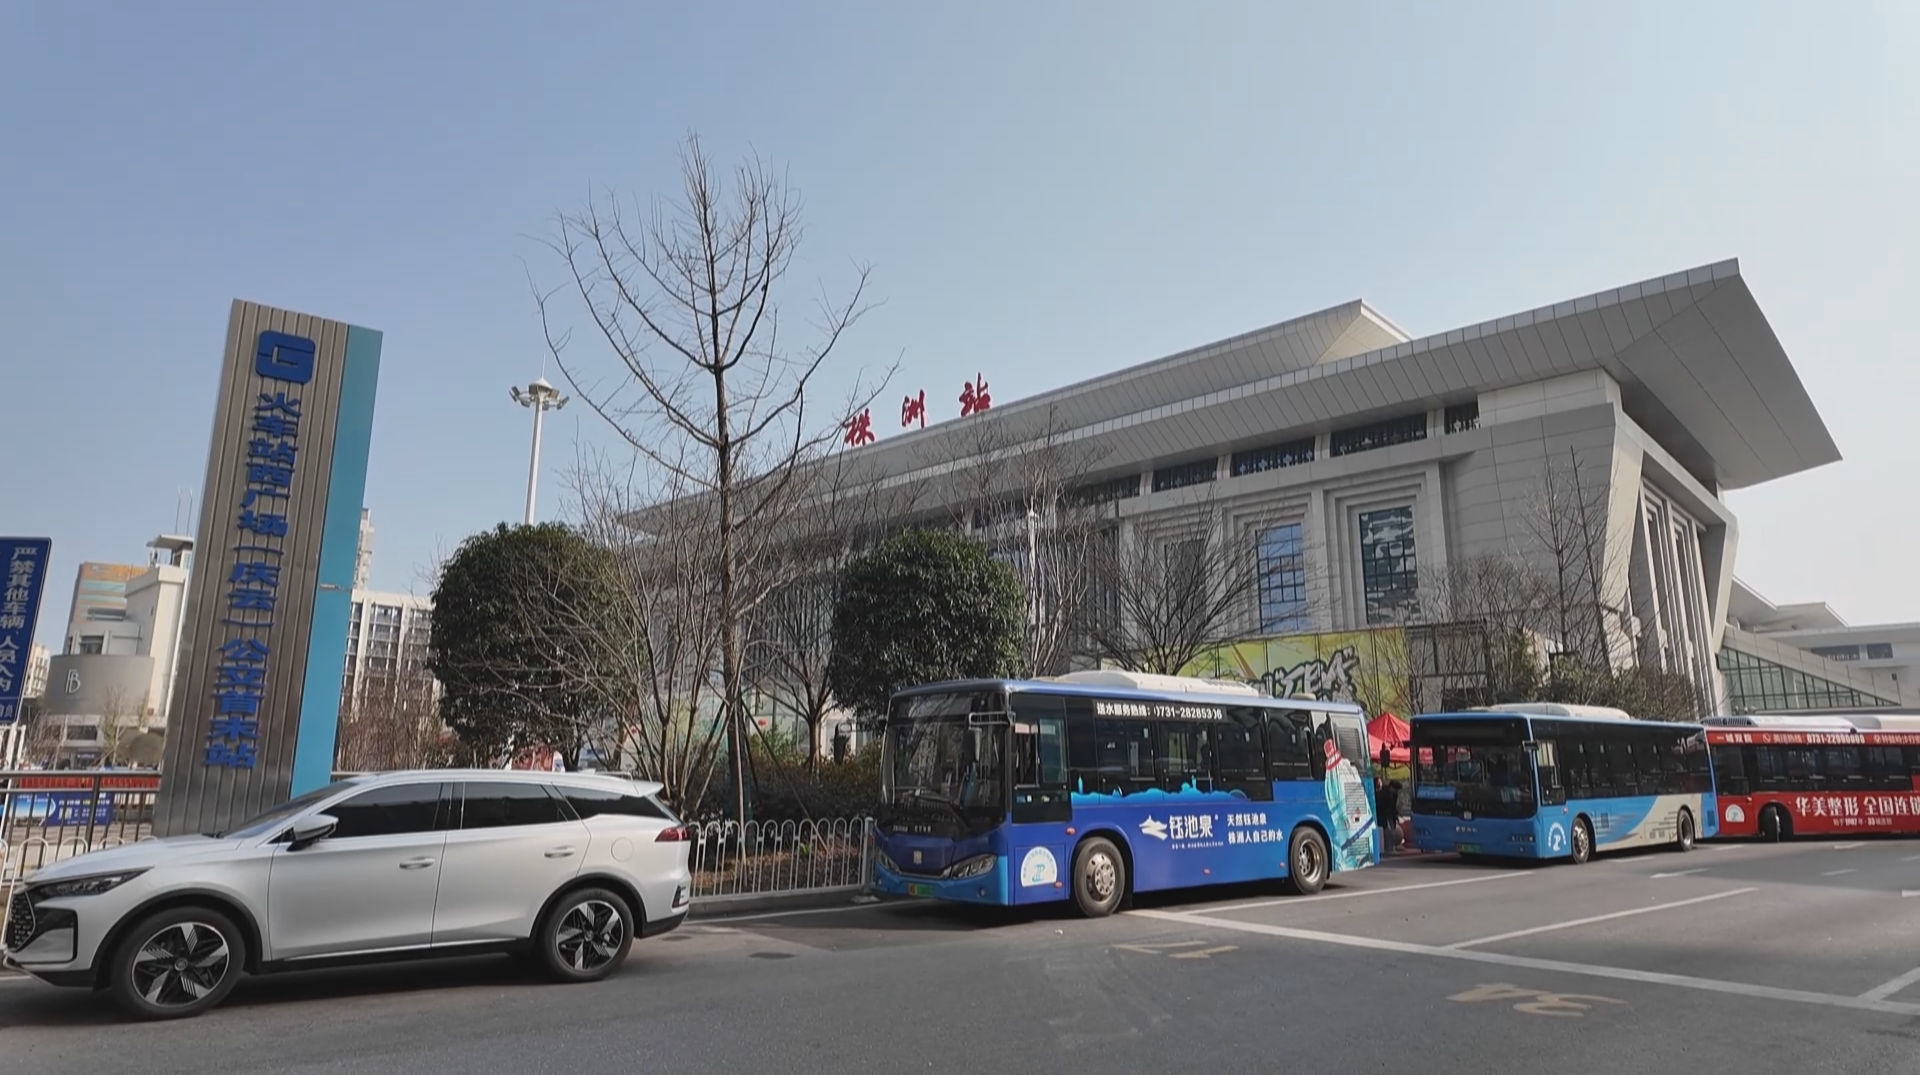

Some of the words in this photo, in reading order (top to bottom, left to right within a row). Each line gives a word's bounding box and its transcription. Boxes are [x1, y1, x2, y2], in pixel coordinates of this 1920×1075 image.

[842, 372, 992, 446] 株洲站
[1795, 796, 1859, 816] 华美整形
[1227, 812, 1267, 827] 天然钰池泉
[1228, 829, 1283, 844] 株洲人自己的水
